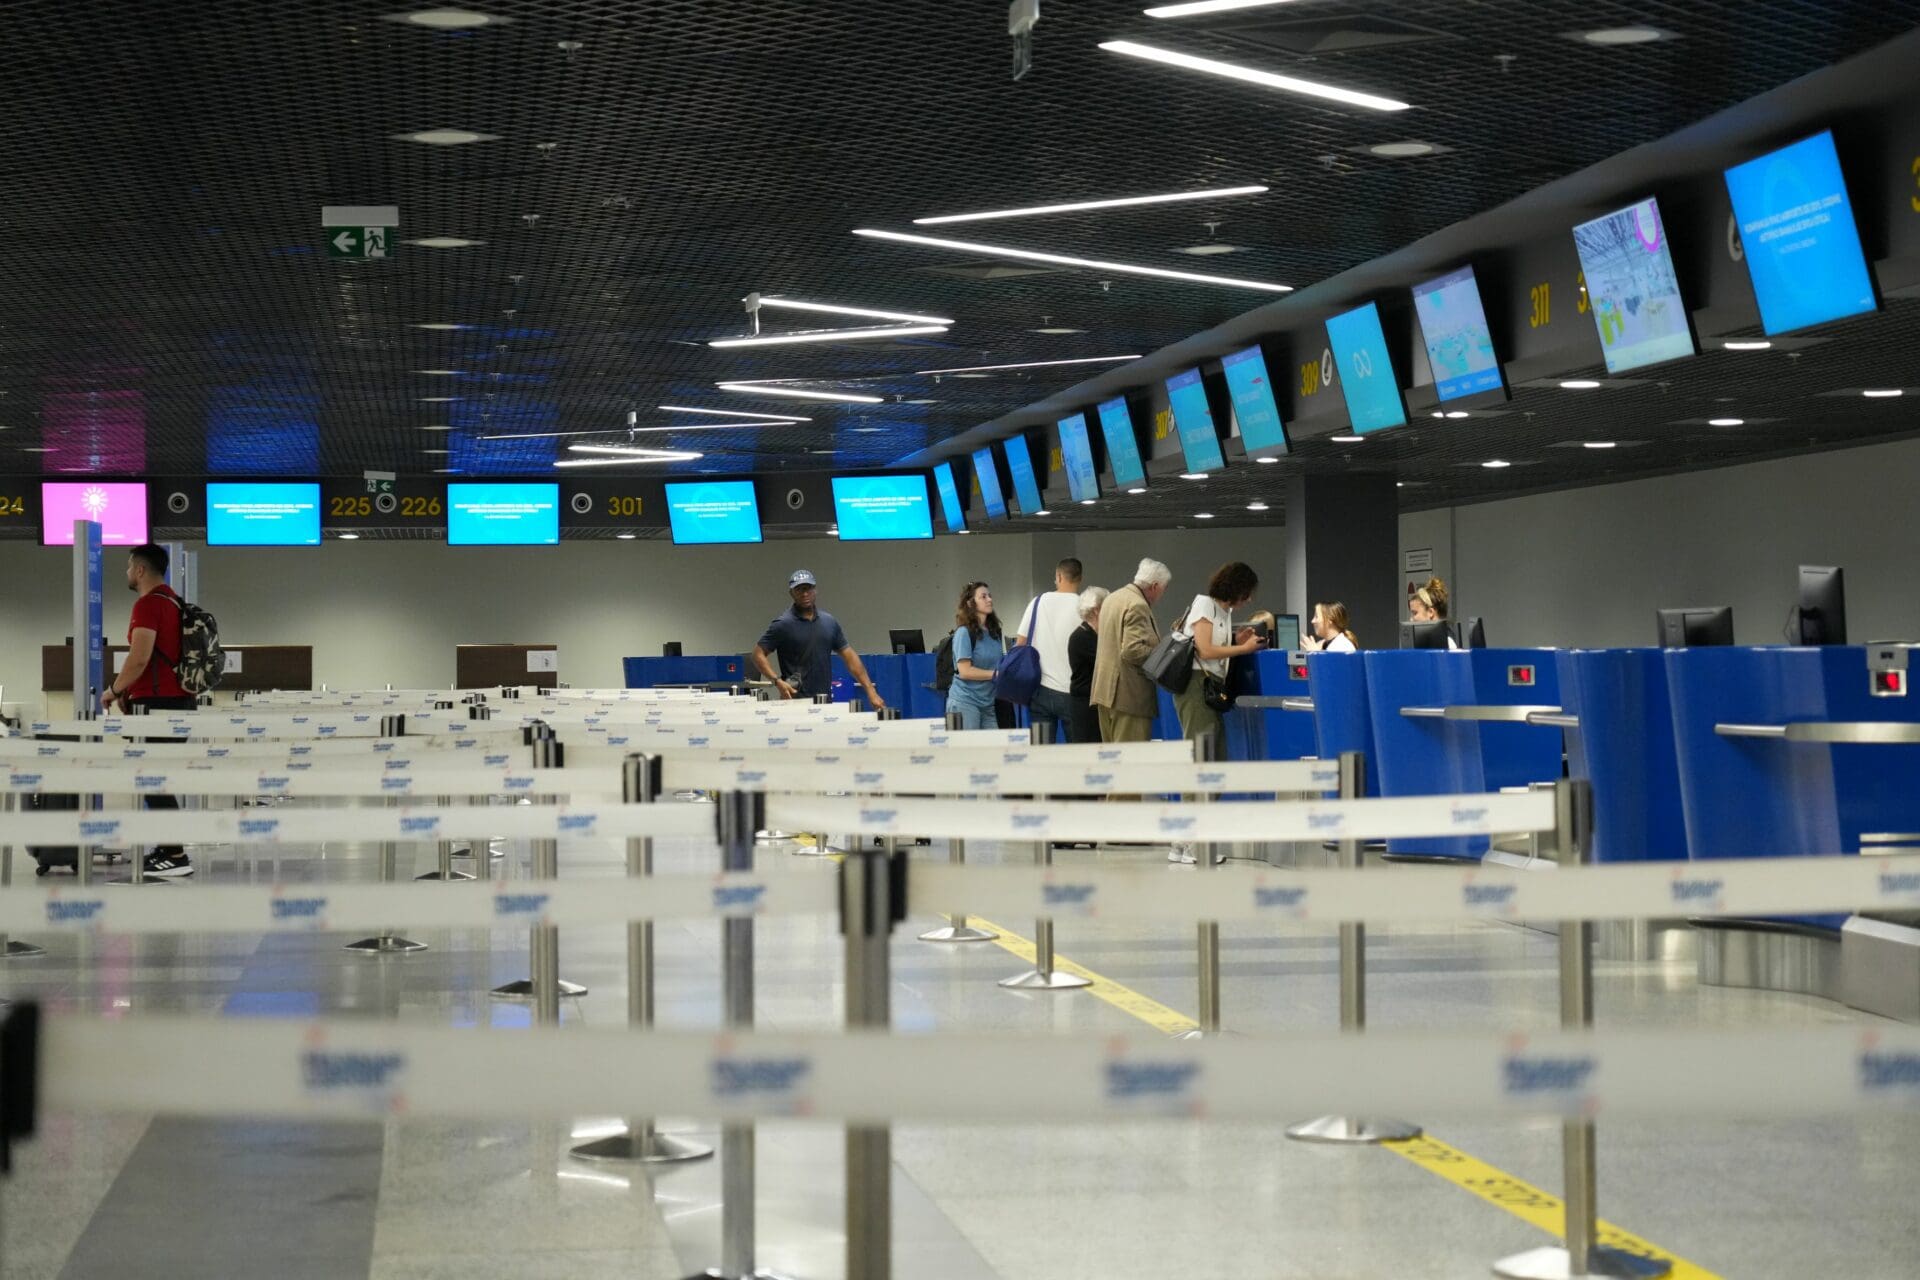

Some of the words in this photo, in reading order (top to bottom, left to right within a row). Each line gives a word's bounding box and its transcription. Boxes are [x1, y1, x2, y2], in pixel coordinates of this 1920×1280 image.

[1529, 282, 1550, 329] 311
[1300, 360, 1320, 397] 309
[331, 497, 372, 516] 225
[401, 497, 441, 516] 226
[608, 496, 643, 516] 301
